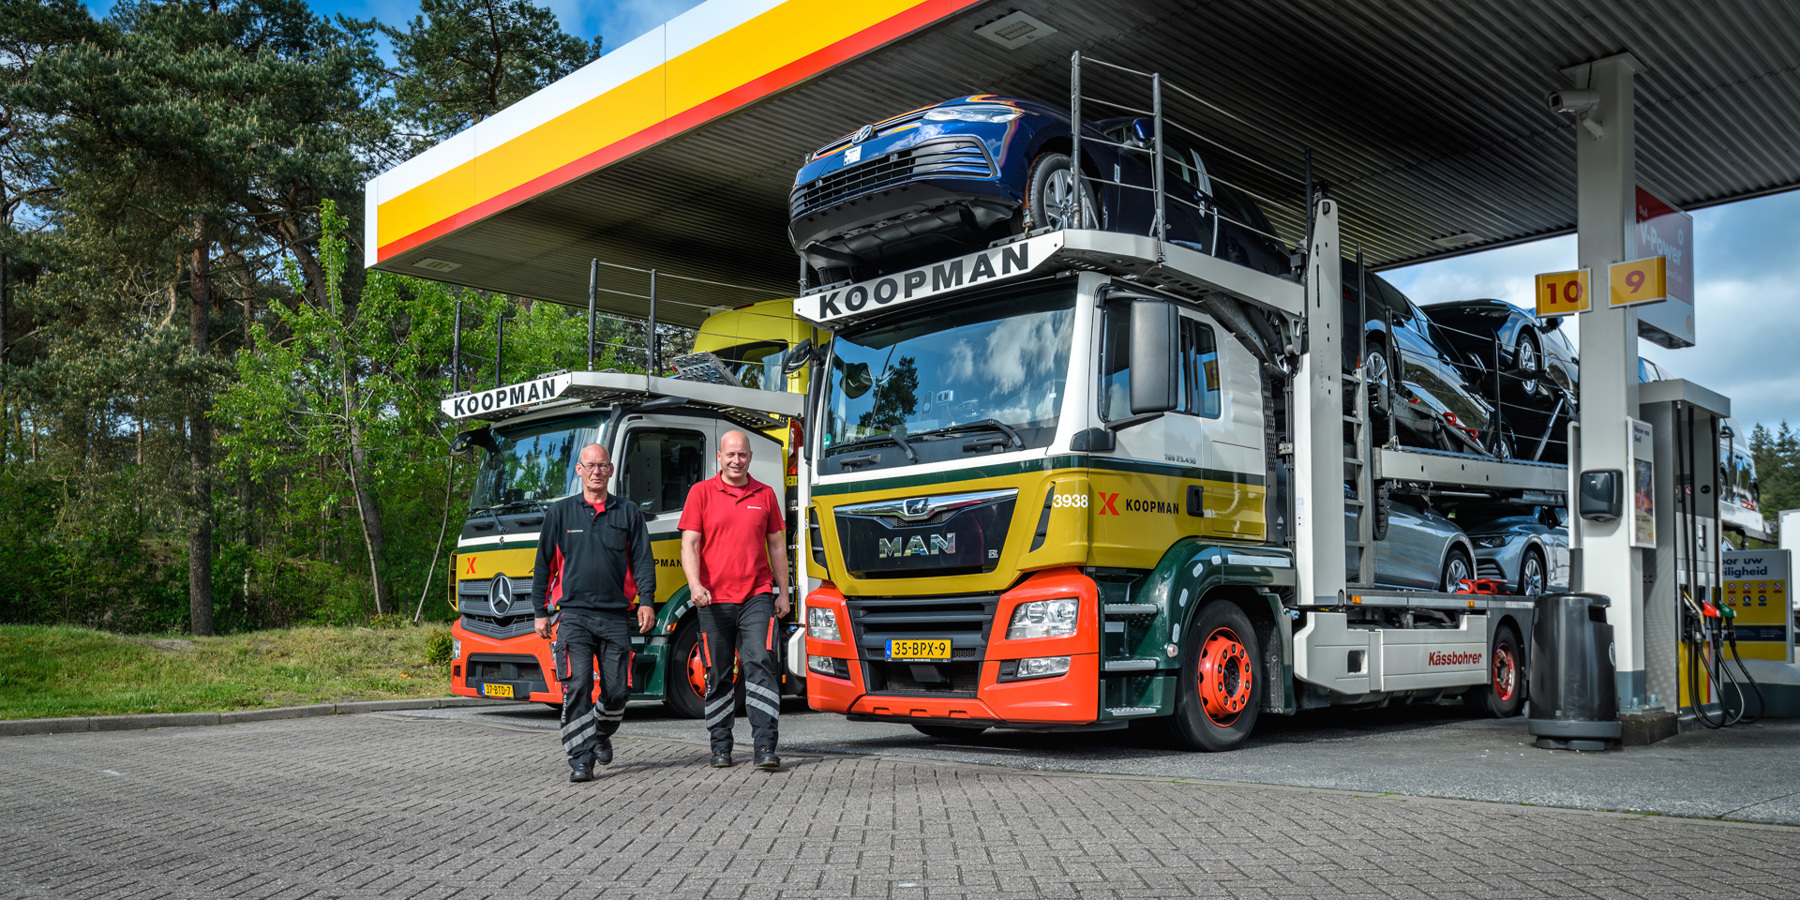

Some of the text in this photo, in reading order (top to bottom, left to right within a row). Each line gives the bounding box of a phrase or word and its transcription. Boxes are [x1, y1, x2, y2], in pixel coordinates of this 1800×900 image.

[1639, 219, 1682, 266] V-Power
[819, 242, 1029, 320] KOOPMAN
[1547, 280, 1583, 304] 10
[1625, 270, 1645, 294] 9
[454, 379, 555, 416] KOOPMAN
[1053, 494, 1088, 508] 3938
[1126, 499, 1179, 514] KOOPMAN
[879, 532, 956, 558] MAN
[894, 642, 946, 656] 35-BPX-9
[1428, 650, 1482, 666] Kässbohrer
